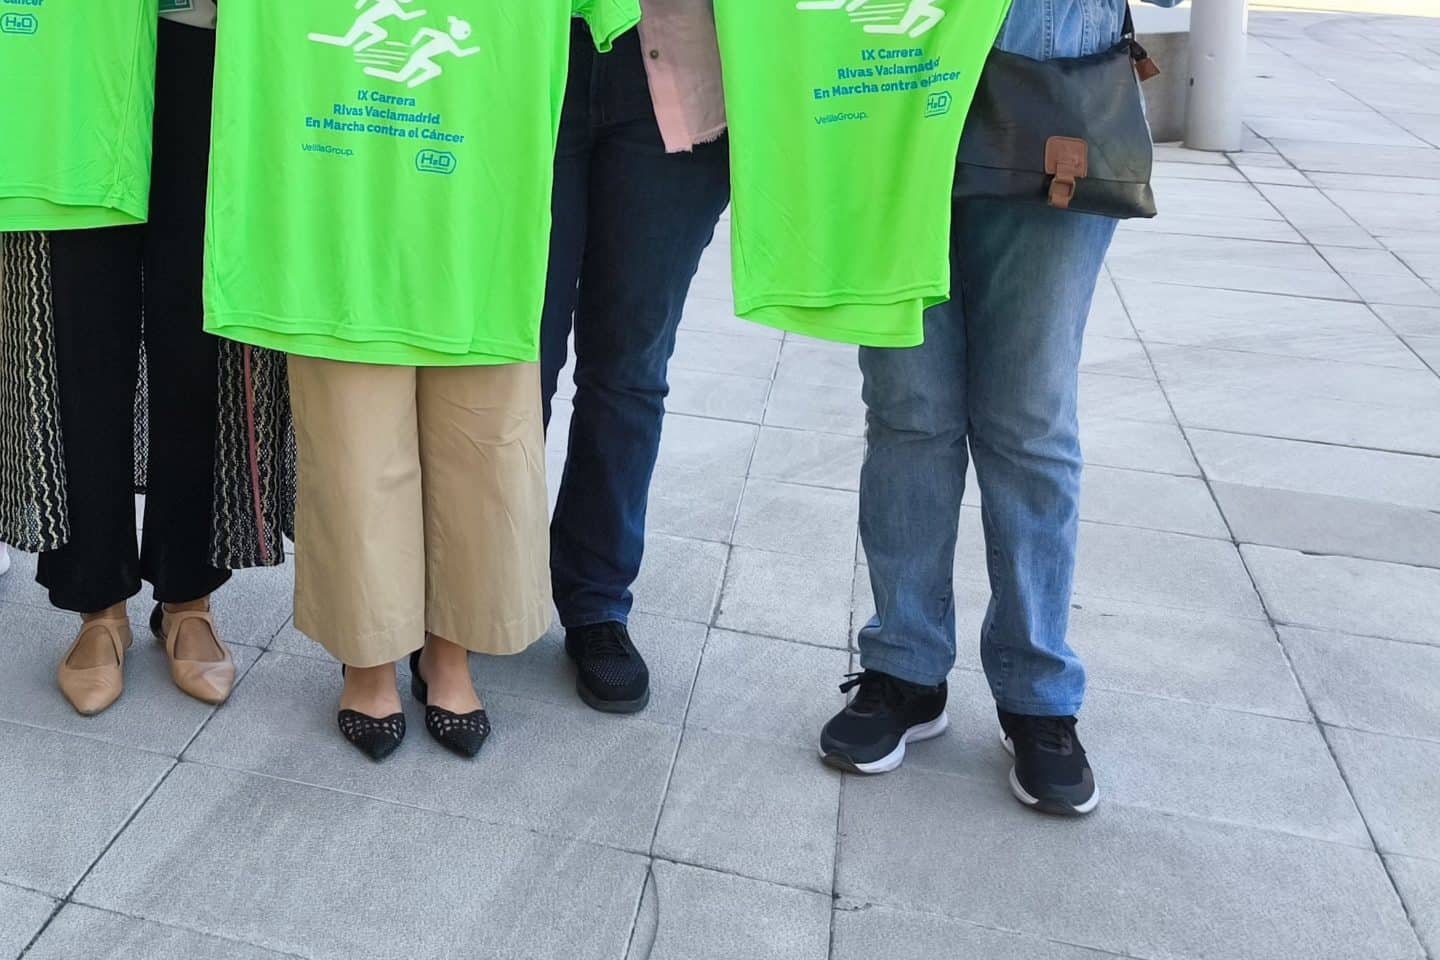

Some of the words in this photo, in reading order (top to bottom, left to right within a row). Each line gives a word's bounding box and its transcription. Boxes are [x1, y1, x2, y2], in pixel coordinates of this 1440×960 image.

[862, 49, 875, 60] IX
[878, 48, 922, 59] Carrera
[838, 68, 873, 79] Rivas
[357, 90, 368, 100] IX
[371, 91, 416, 107] Carrera
[814, 89, 829, 100] En
[832, 82, 878, 96] Marcha
[881, 80, 917, 92] contra
[333, 103, 363, 116] Rivas
[365, 106, 440, 125] Vaciamadrid
[306, 117, 320, 128] En
[323, 119, 365, 132] Marcha
[367, 123, 405, 138] contra
[408, 126, 418, 138] el
[421, 128, 464, 143] Cáncer
